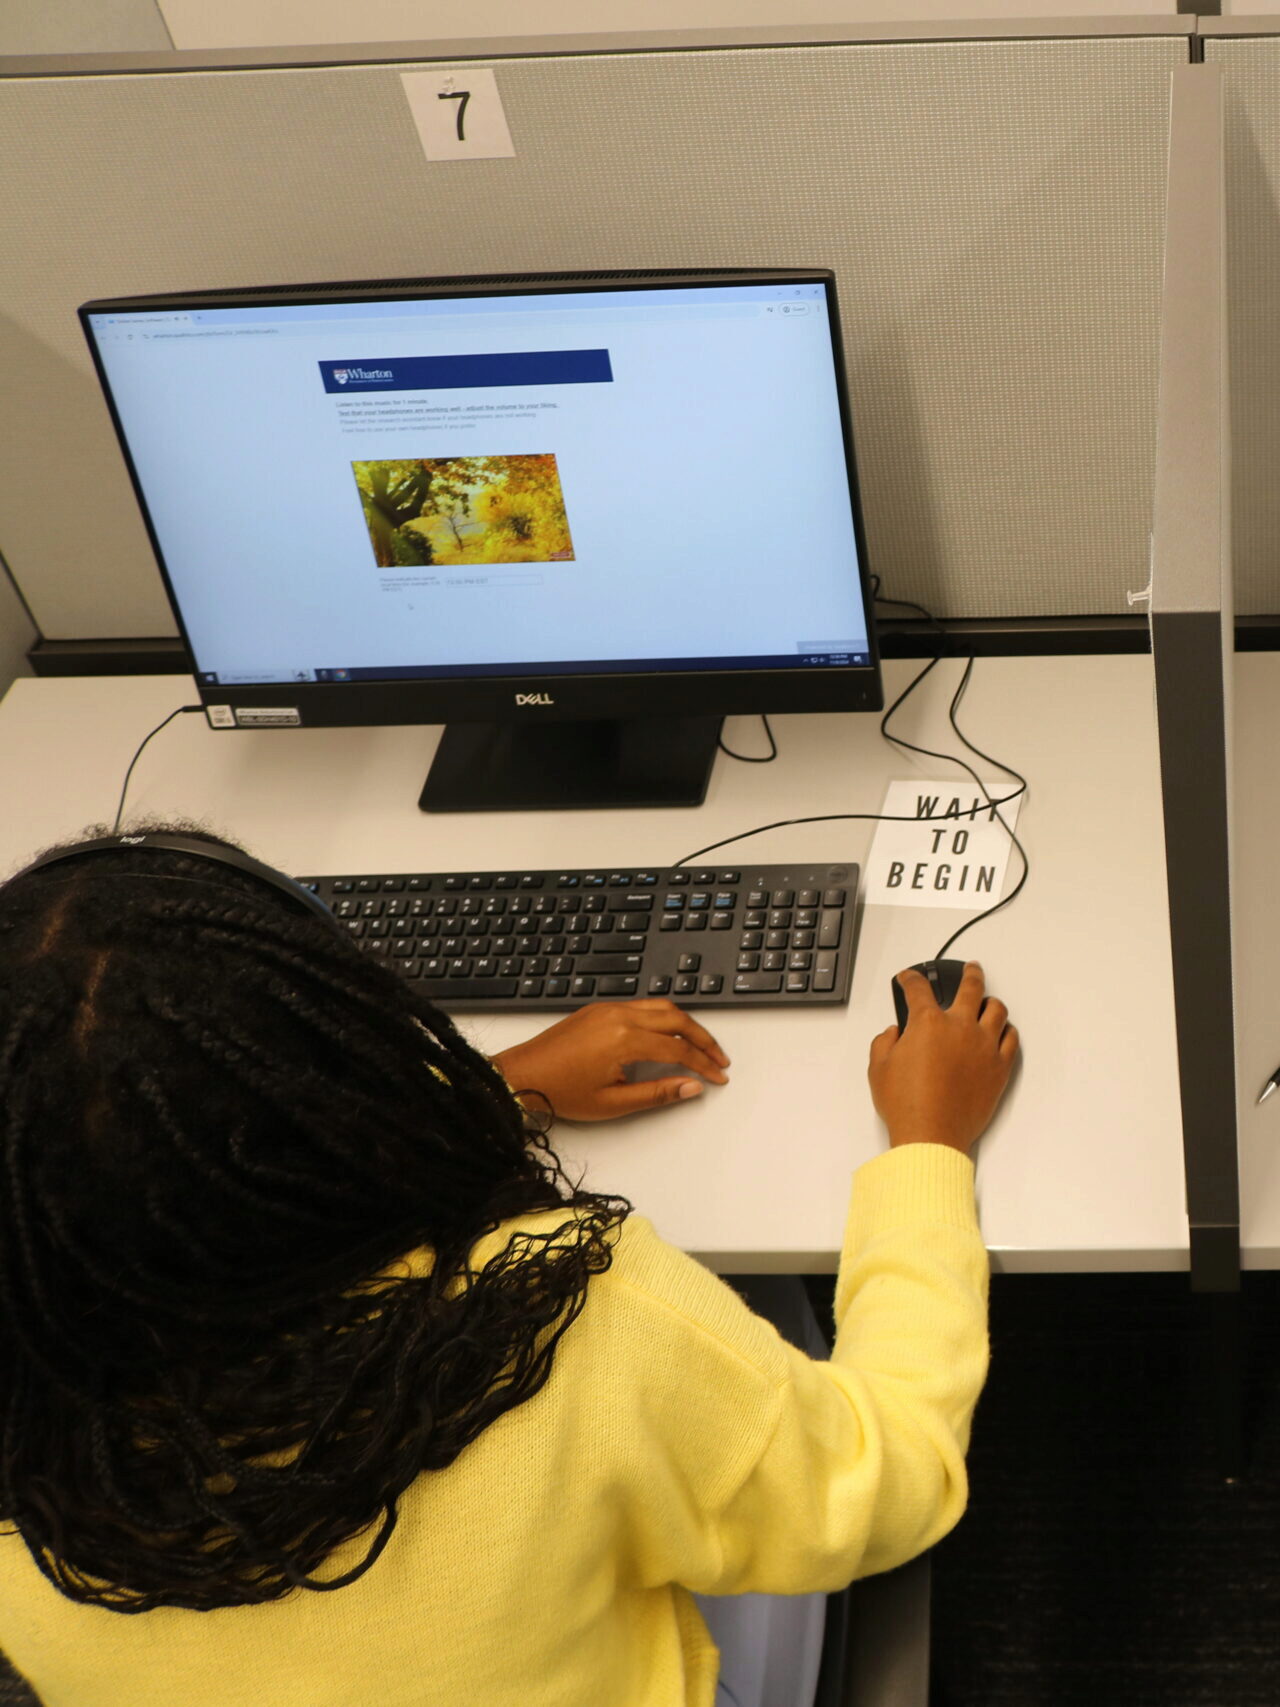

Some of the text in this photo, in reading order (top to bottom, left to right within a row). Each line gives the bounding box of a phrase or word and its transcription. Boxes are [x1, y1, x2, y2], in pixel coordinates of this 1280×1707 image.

[438, 91, 470, 141] 7
[347, 368, 393, 379] Wharton
[515, 693, 554, 706] DELL
[916, 795, 1001, 822] WAIT
[931, 829, 969, 855] TO
[887, 862, 996, 892] BEGIN
